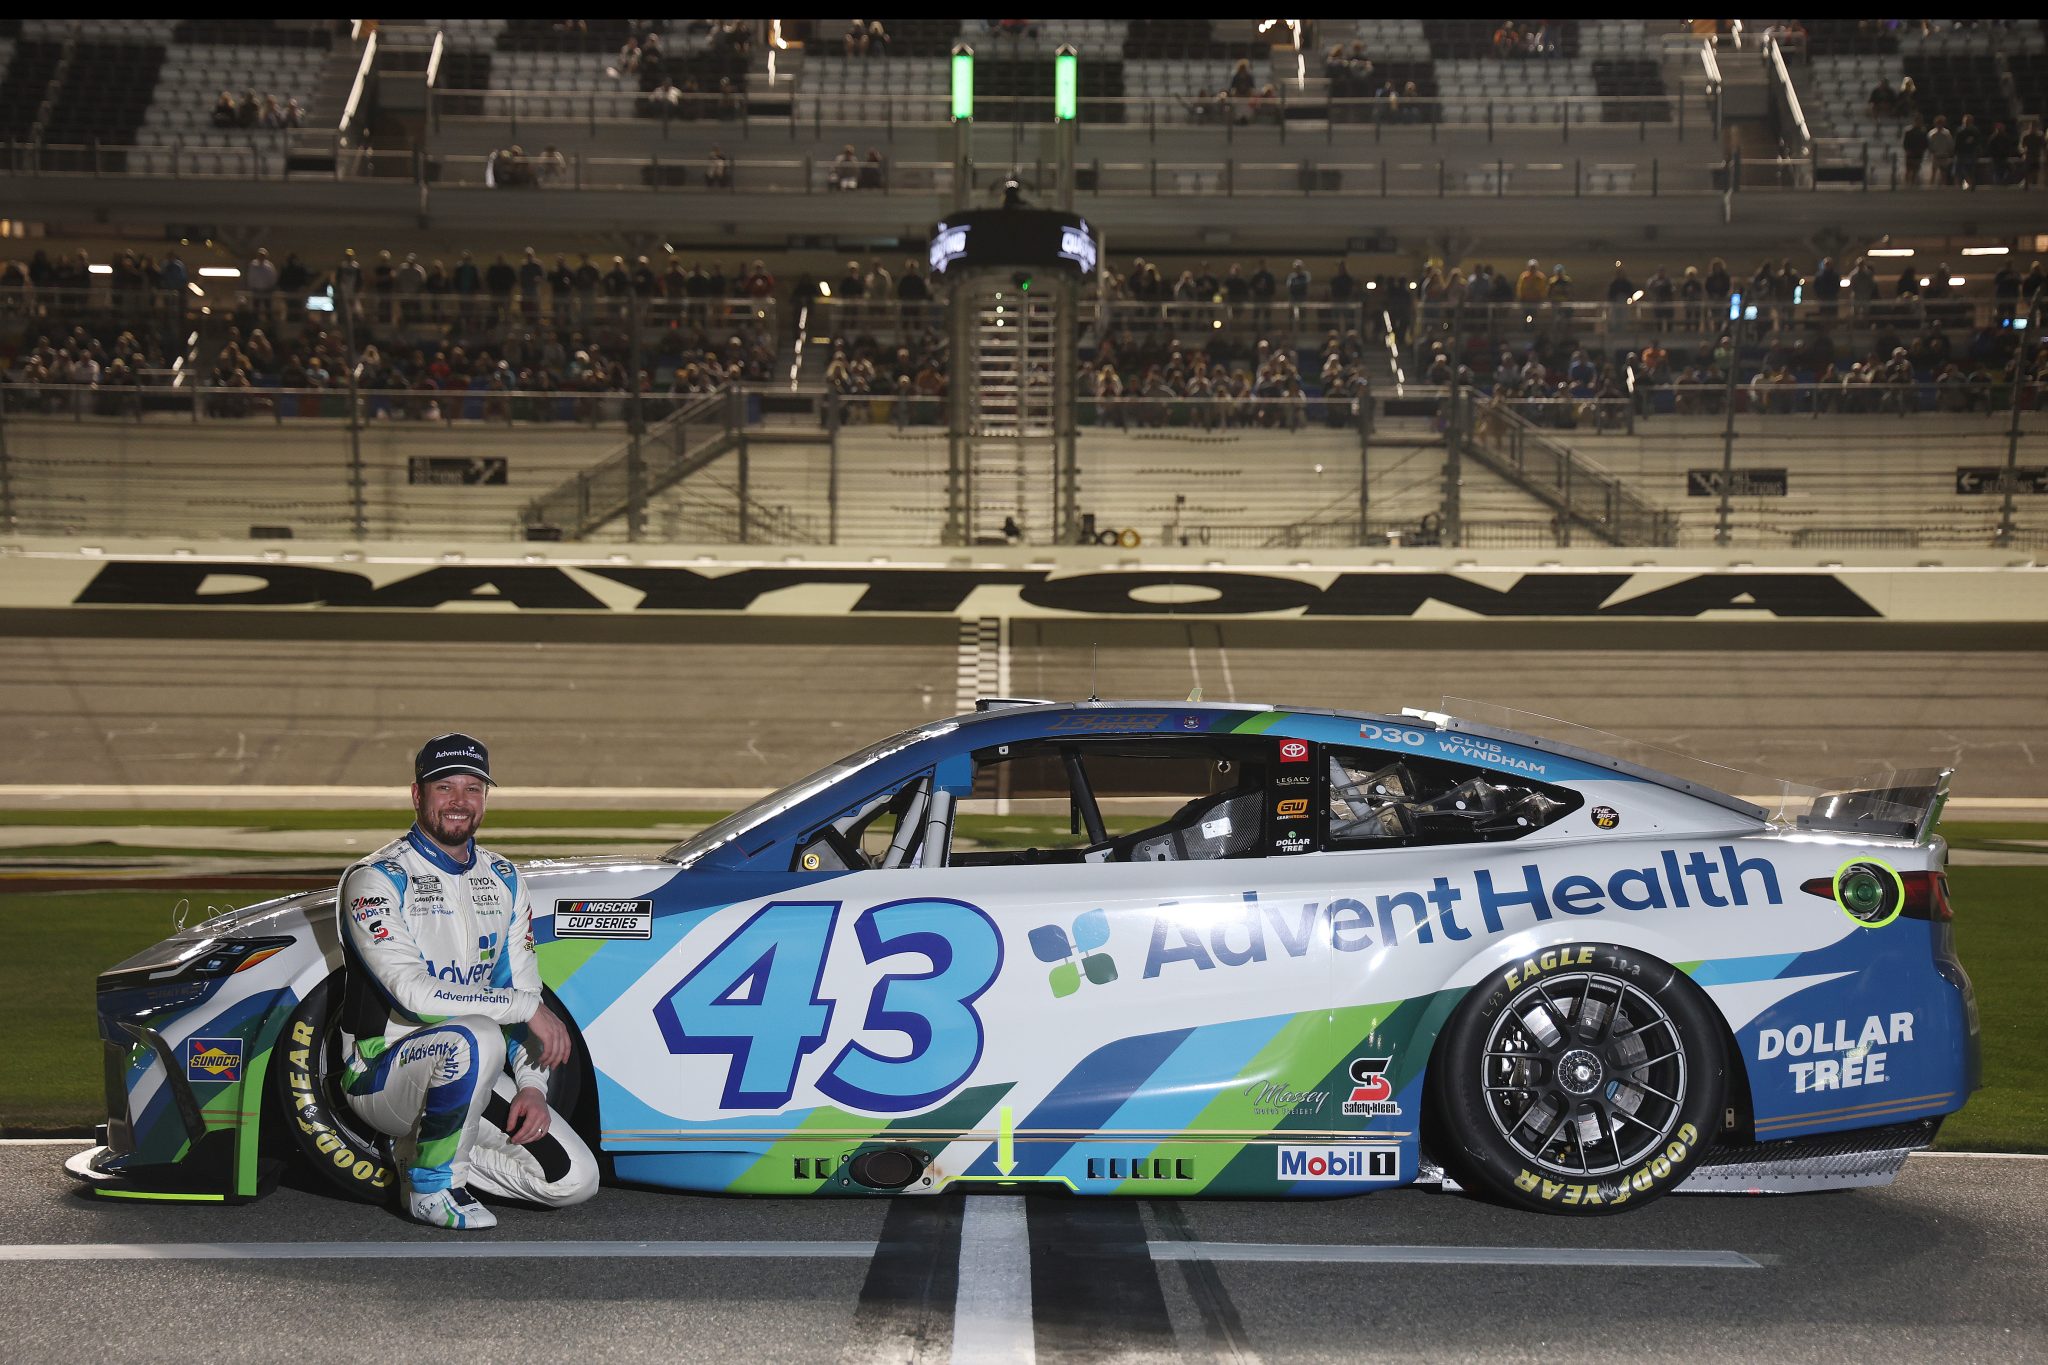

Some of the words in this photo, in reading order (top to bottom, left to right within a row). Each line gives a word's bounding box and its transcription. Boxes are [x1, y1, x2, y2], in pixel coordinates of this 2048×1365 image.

[73, 561, 1886, 620] DAYTONA
[1450, 736, 1502, 753] CLUB
[1439, 741, 1546, 774] WYNDHAM
[1598, 817, 1614, 827] 16
[1276, 838, 1311, 847] DOLLAR
[1282, 845, 1304, 853] TREE
[468, 877, 497, 887] TOYOA
[586, 902, 639, 913] NASCAR
[568, 917, 594, 928] CUP
[595, 917, 639, 929] SERIES
[1503, 946, 1596, 992] EAGLE
[434, 989, 510, 1004] AdventHealth
[652, 896, 1004, 1112] 43
[1758, 1012, 1914, 1060] DOLLAR
[192, 1055, 239, 1068] SUNOCO
[1789, 1052, 1887, 1094] TREE
[1243, 1079, 1330, 1114] Massey
[1281, 1151, 1363, 1176] Mobil
[1513, 1122, 1699, 1206] GOODYEAR
